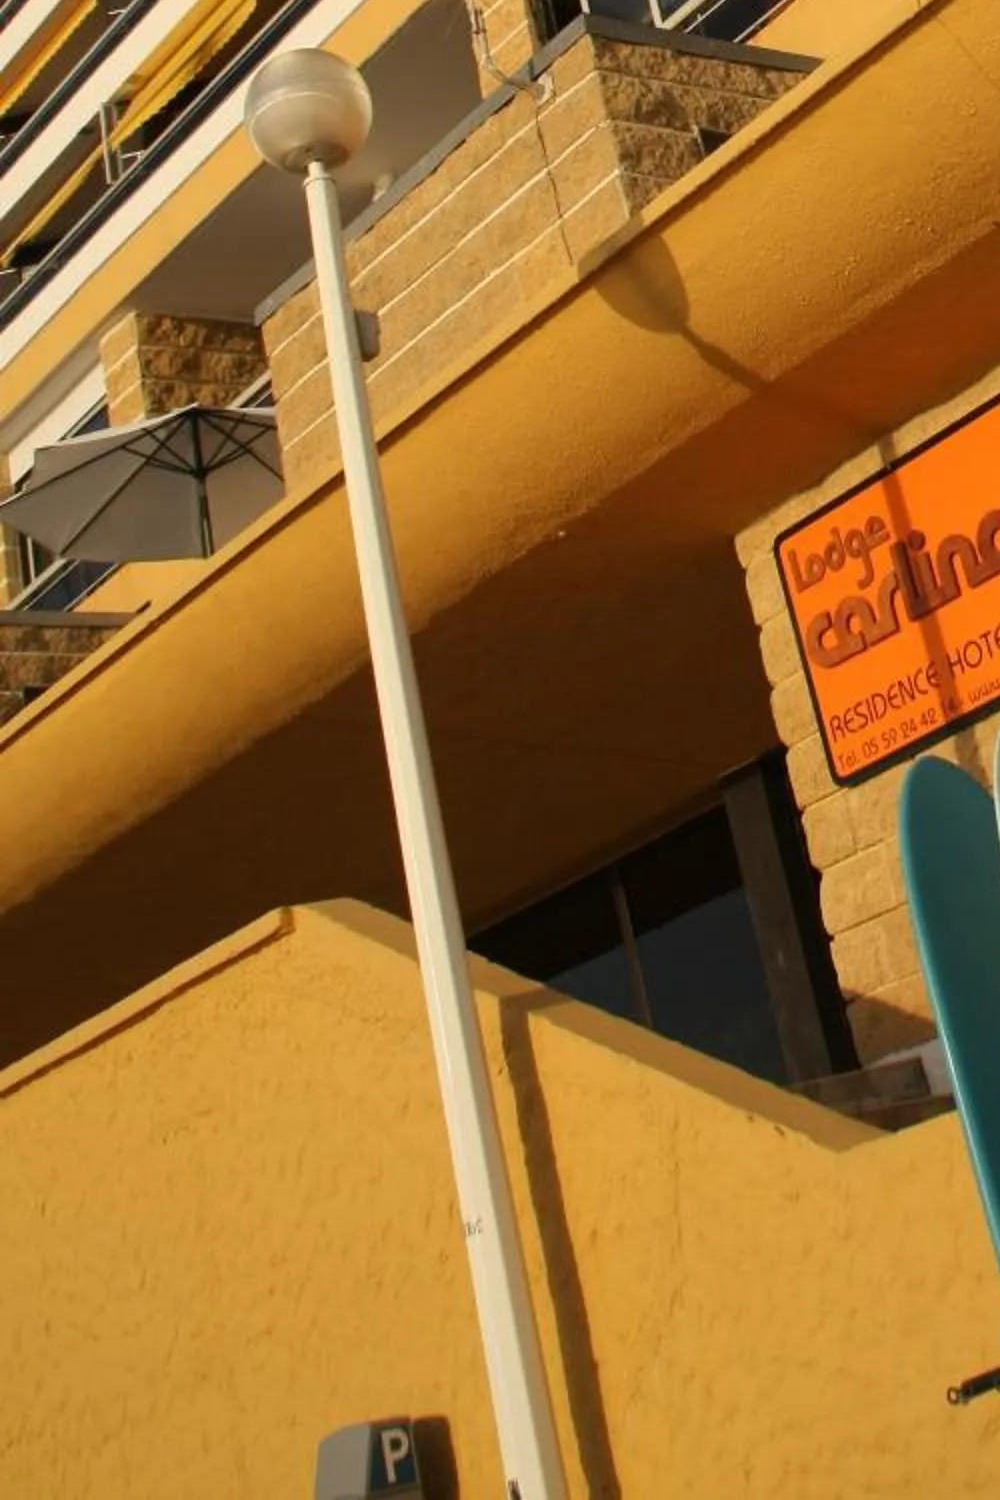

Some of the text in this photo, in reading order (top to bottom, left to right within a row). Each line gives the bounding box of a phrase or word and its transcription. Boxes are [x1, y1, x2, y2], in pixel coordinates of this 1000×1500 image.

[829, 660, 942, 743] RESIDENCE
[861, 736, 880, 759] 05
[881, 727, 898, 750] 59
[380, 1427, 410, 1484] P
